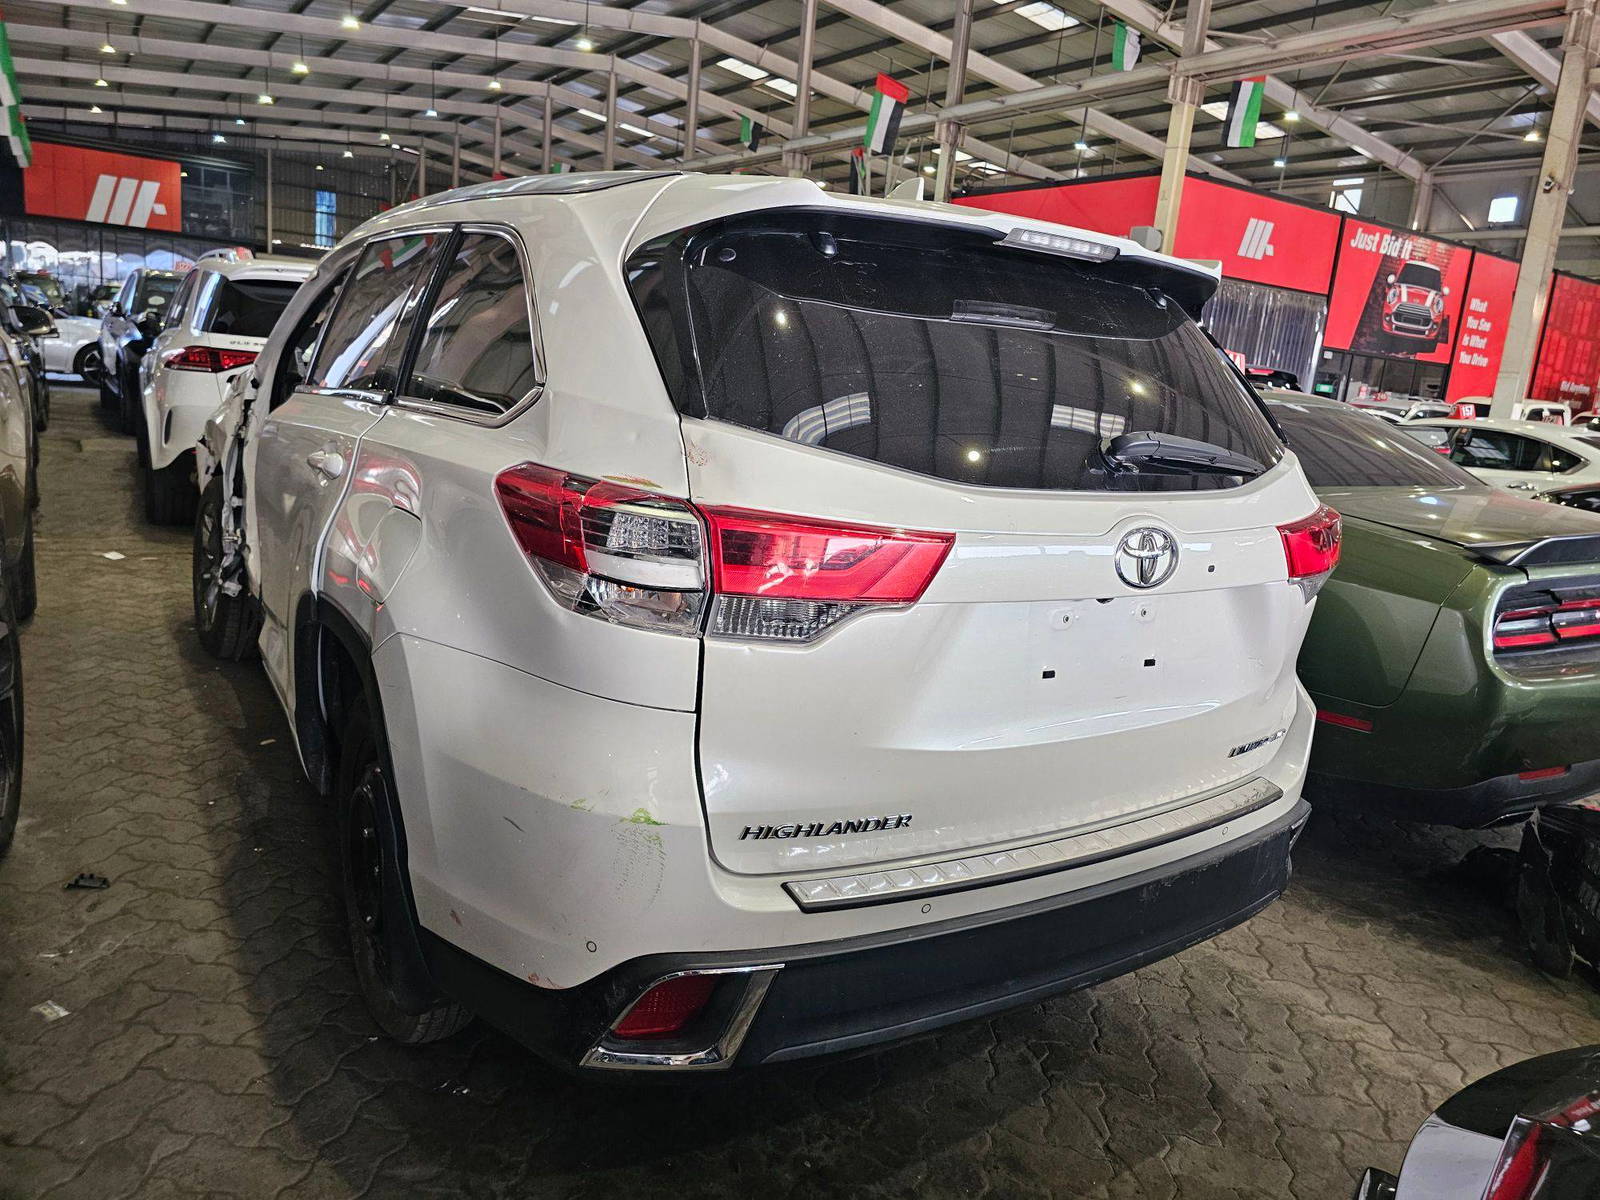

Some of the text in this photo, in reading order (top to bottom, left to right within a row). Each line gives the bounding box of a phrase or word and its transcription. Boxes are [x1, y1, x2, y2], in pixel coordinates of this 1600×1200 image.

[1350, 227, 1413, 260] Just Bid It
[1469, 298, 1488, 313] What
[1466, 315, 1492, 332] You See
[1469, 334, 1488, 349] What
[1459, 351, 1489, 368] You Drive
[739, 814, 913, 840] HIGHLANDER
